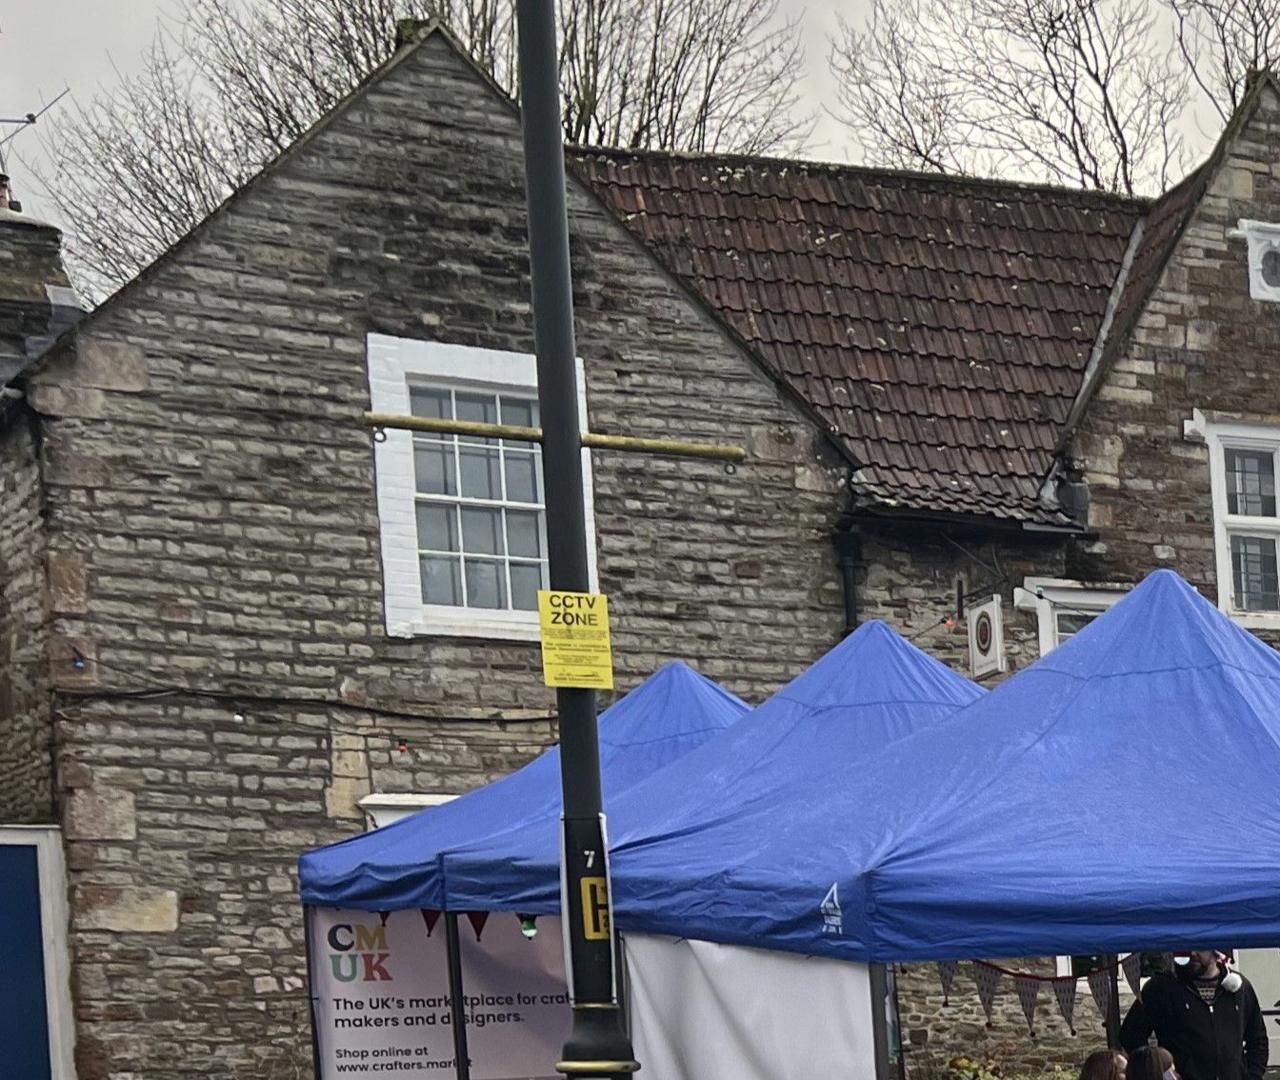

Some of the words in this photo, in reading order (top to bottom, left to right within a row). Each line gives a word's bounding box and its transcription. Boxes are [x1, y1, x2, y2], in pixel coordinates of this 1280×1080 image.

[549, 594, 596, 609] CCTV
[551, 611, 598, 626] ZONE
[583, 849, 595, 868] 7
[327, 923, 389, 952] CM
[329, 953, 393, 982] UK
[333, 997, 364, 1010] The
[409, 993, 514, 1010] marktplace
[517, 992, 537, 1005] for
[334, 1014, 399, 1028] makers
[404, 1012, 436, 1027] and
[441, 1011, 525, 1028] dsigners.
[335, 1048, 369, 1061] Shop
[372, 1046, 413, 1058] online
[415, 1046, 428, 1057] at
[335, 1057, 472, 1073] www.crafters.markt
